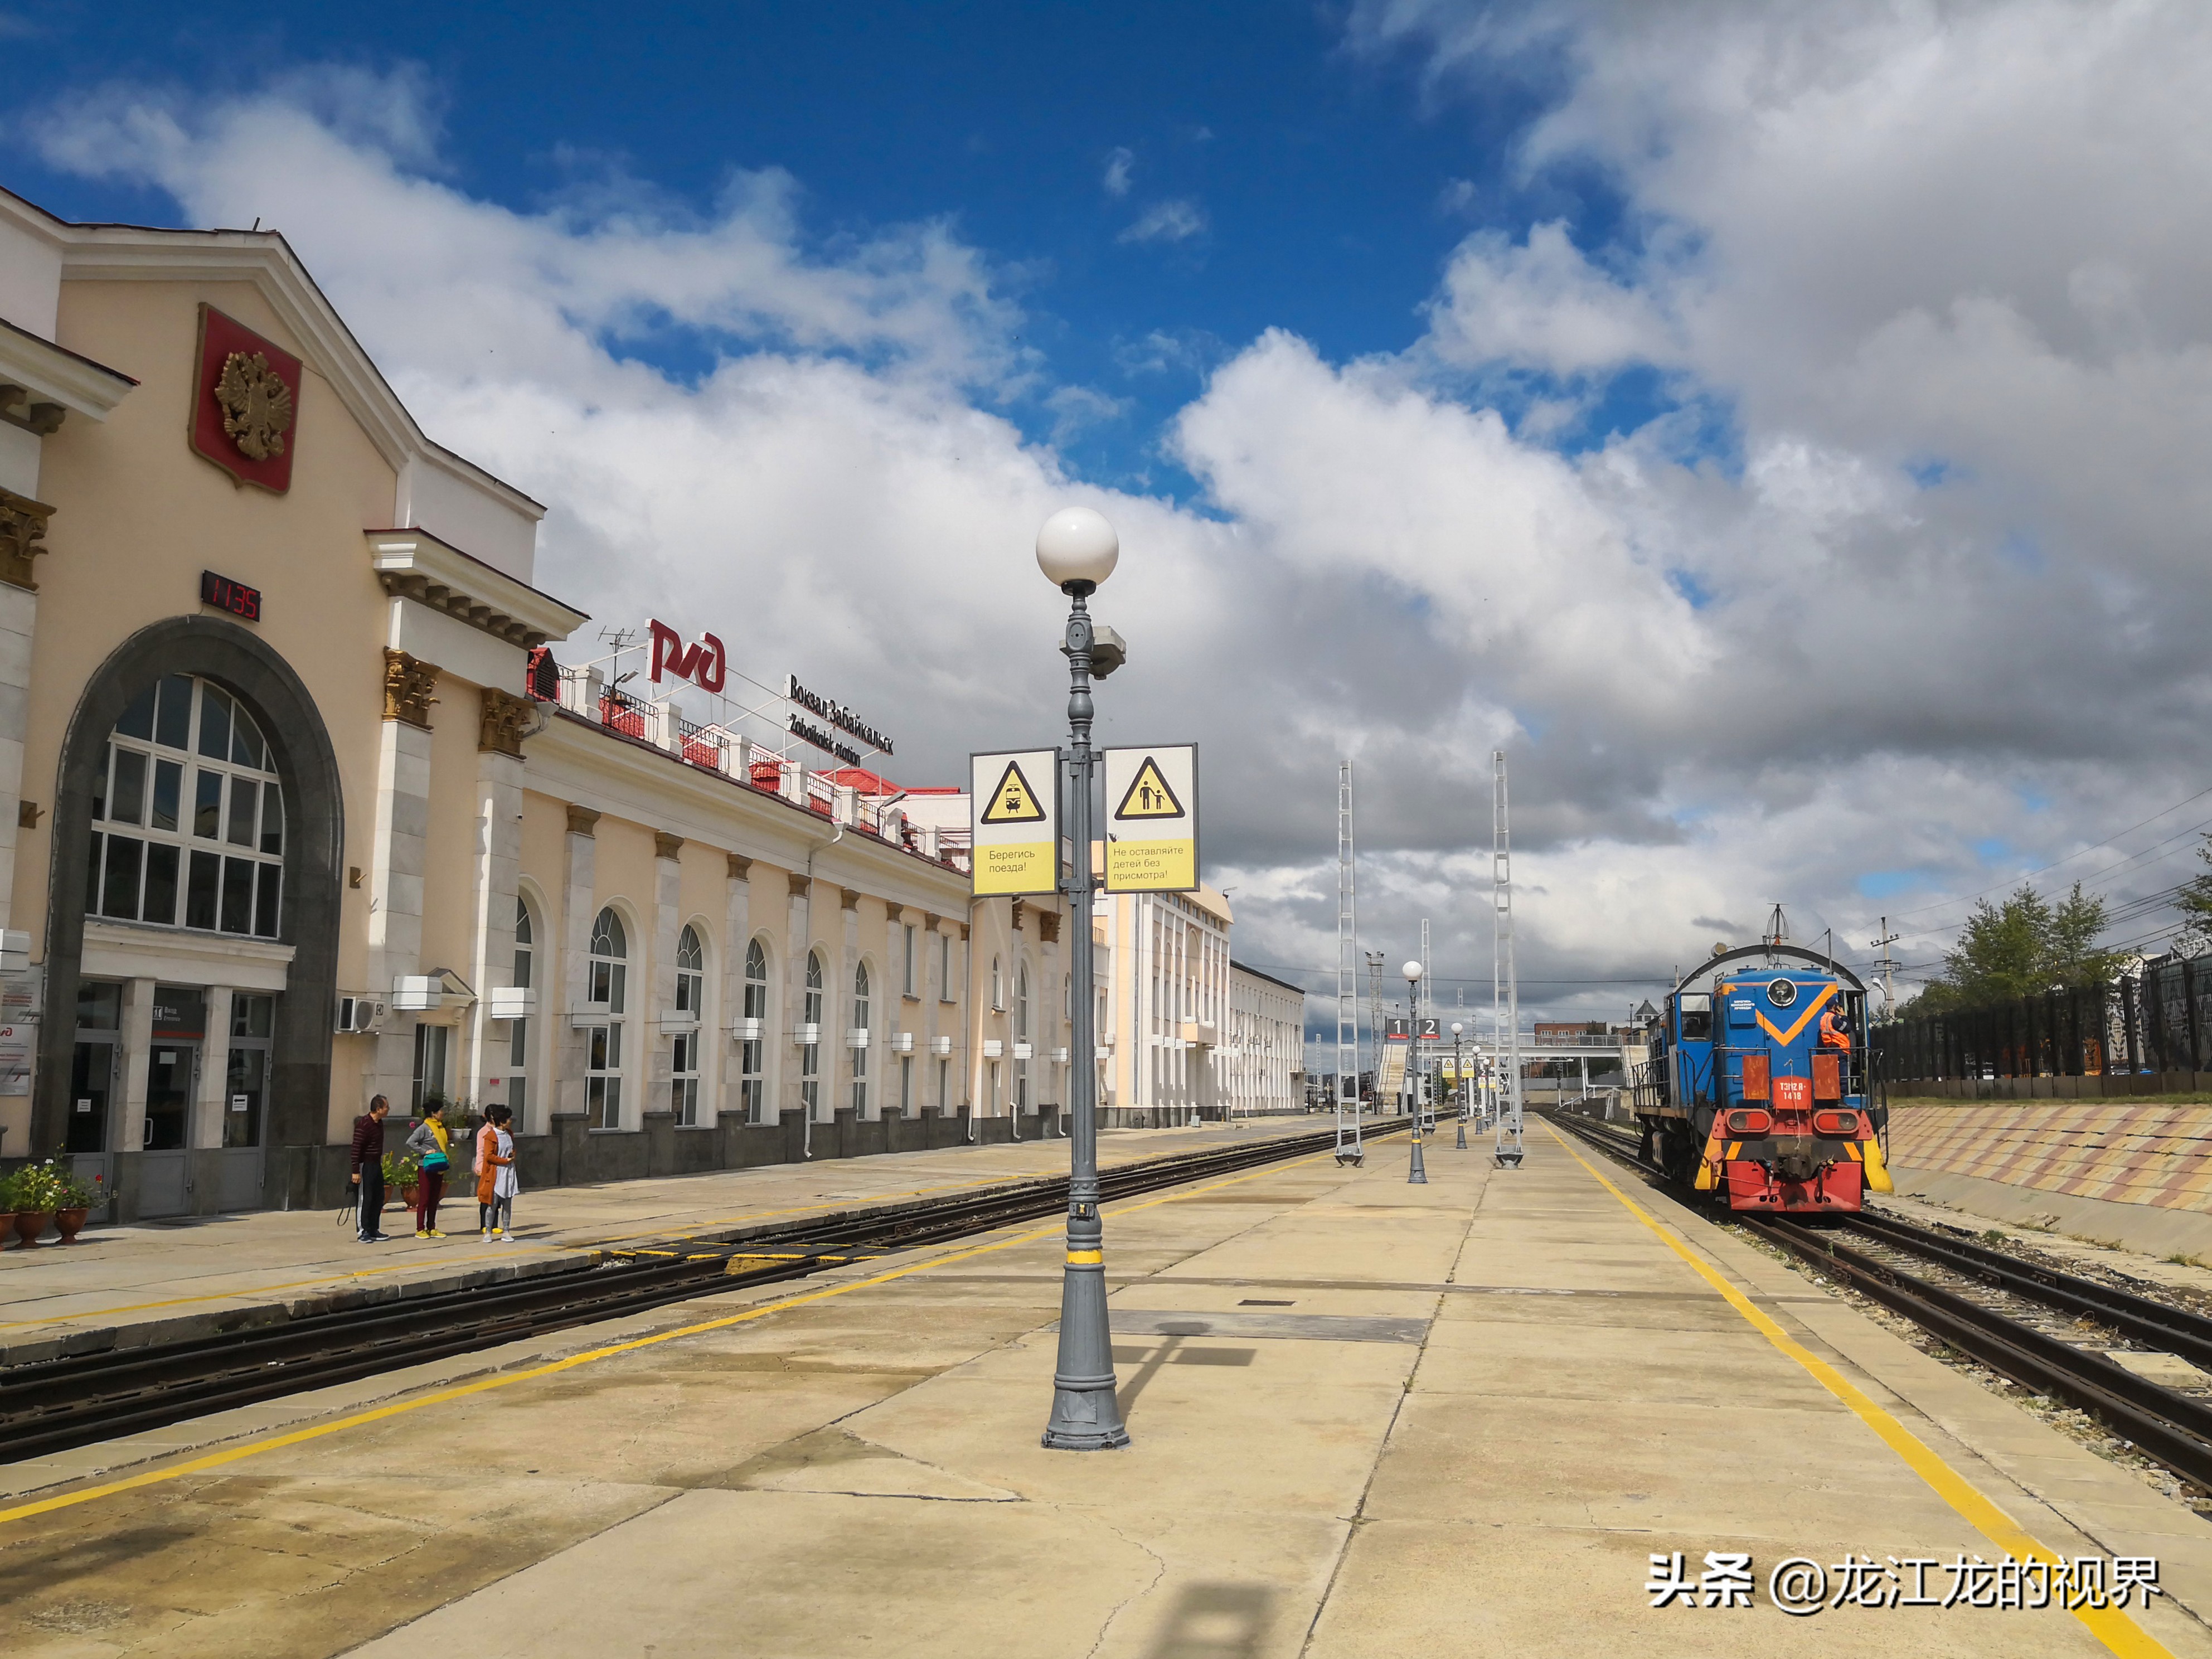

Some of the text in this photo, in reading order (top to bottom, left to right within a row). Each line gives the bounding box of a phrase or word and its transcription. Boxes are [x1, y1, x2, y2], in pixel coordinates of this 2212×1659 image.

[787, 673, 894, 756] Вокзал Забайкальск
[788, 712, 861, 768] Zabaikalsk station
[989, 850, 1035, 861] Берегись
[1129, 847, 1183, 856] оставляйте
[989, 862, 1026, 874] поезда!
[1113, 859, 1160, 870] детей без
[1113, 870, 1168, 881] присмотра!
[1394, 1020, 1401, 1034] 1
[1425, 1020, 1435, 1034] 2
